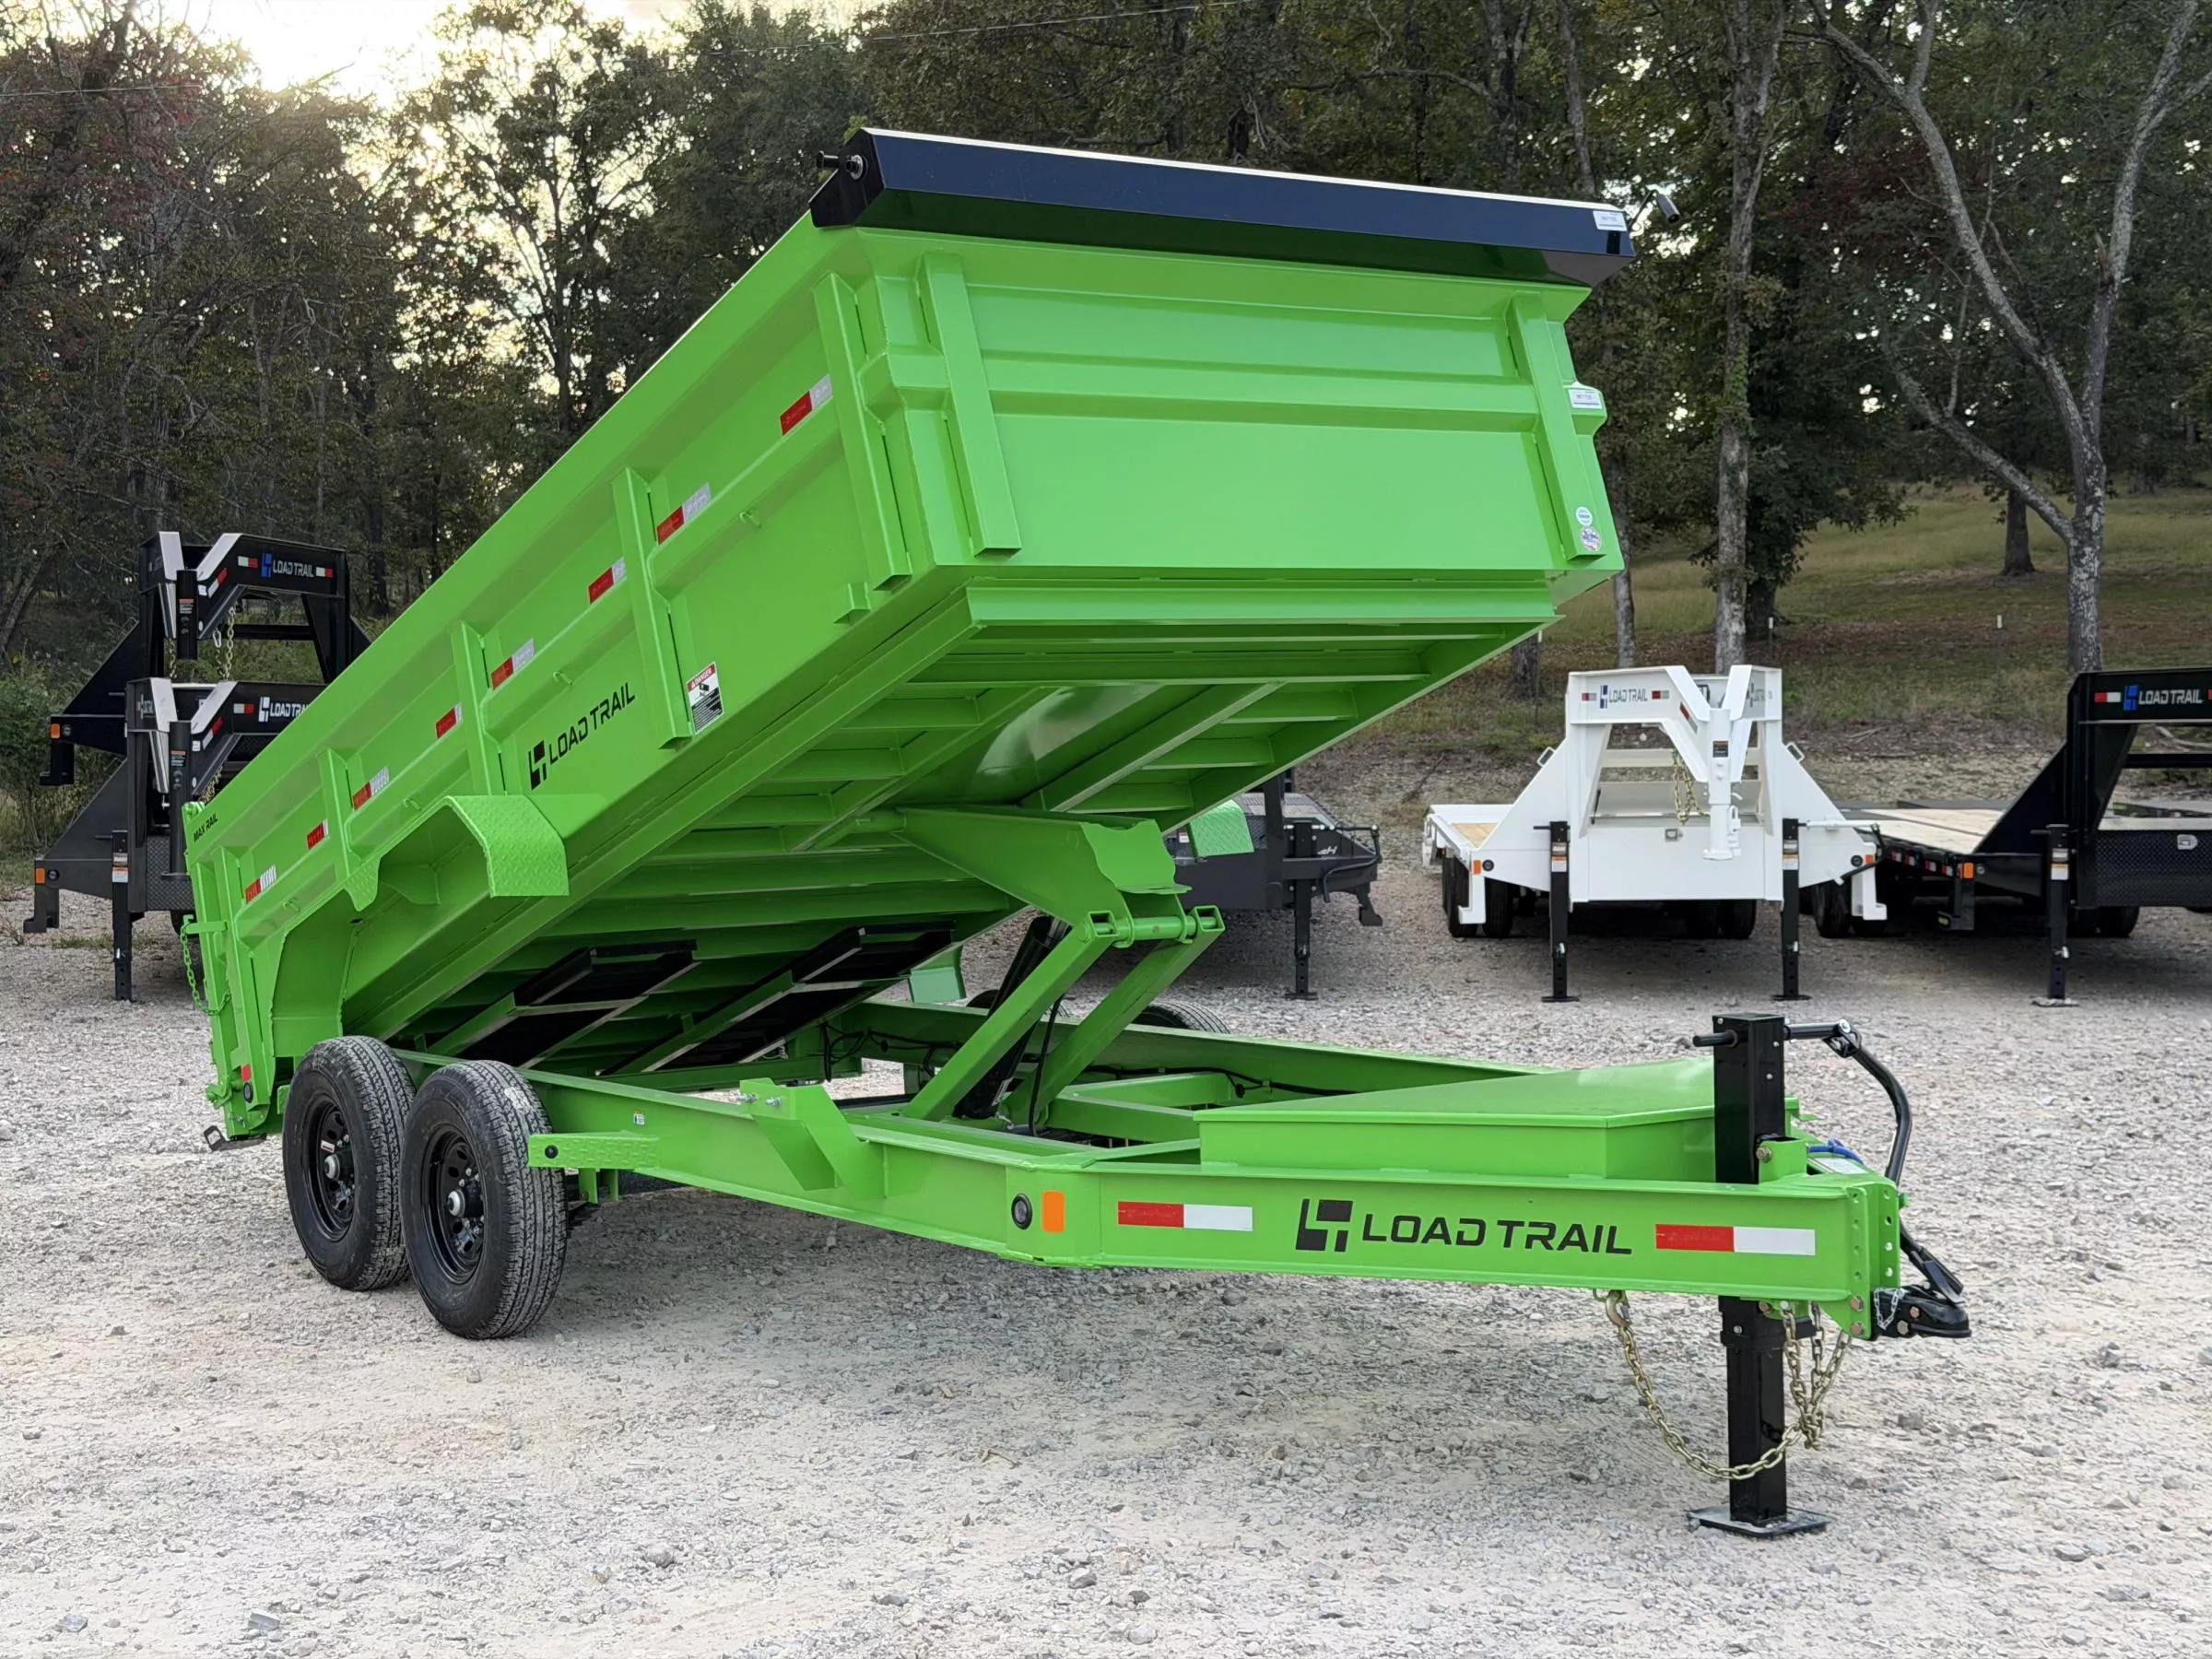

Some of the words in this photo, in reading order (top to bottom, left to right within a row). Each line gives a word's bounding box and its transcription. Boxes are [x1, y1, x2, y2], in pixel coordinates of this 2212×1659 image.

[269, 702, 291, 717] LOAD
[2138, 689, 2169, 705] LOAD
[2170, 688, 2204, 704] TRAIL
[548, 716, 589, 765] LOAD
[590, 682, 636, 732] TRAIL
[1362, 1213, 1487, 1247] LOAD
[1497, 1219, 1632, 1255] TRAIL
